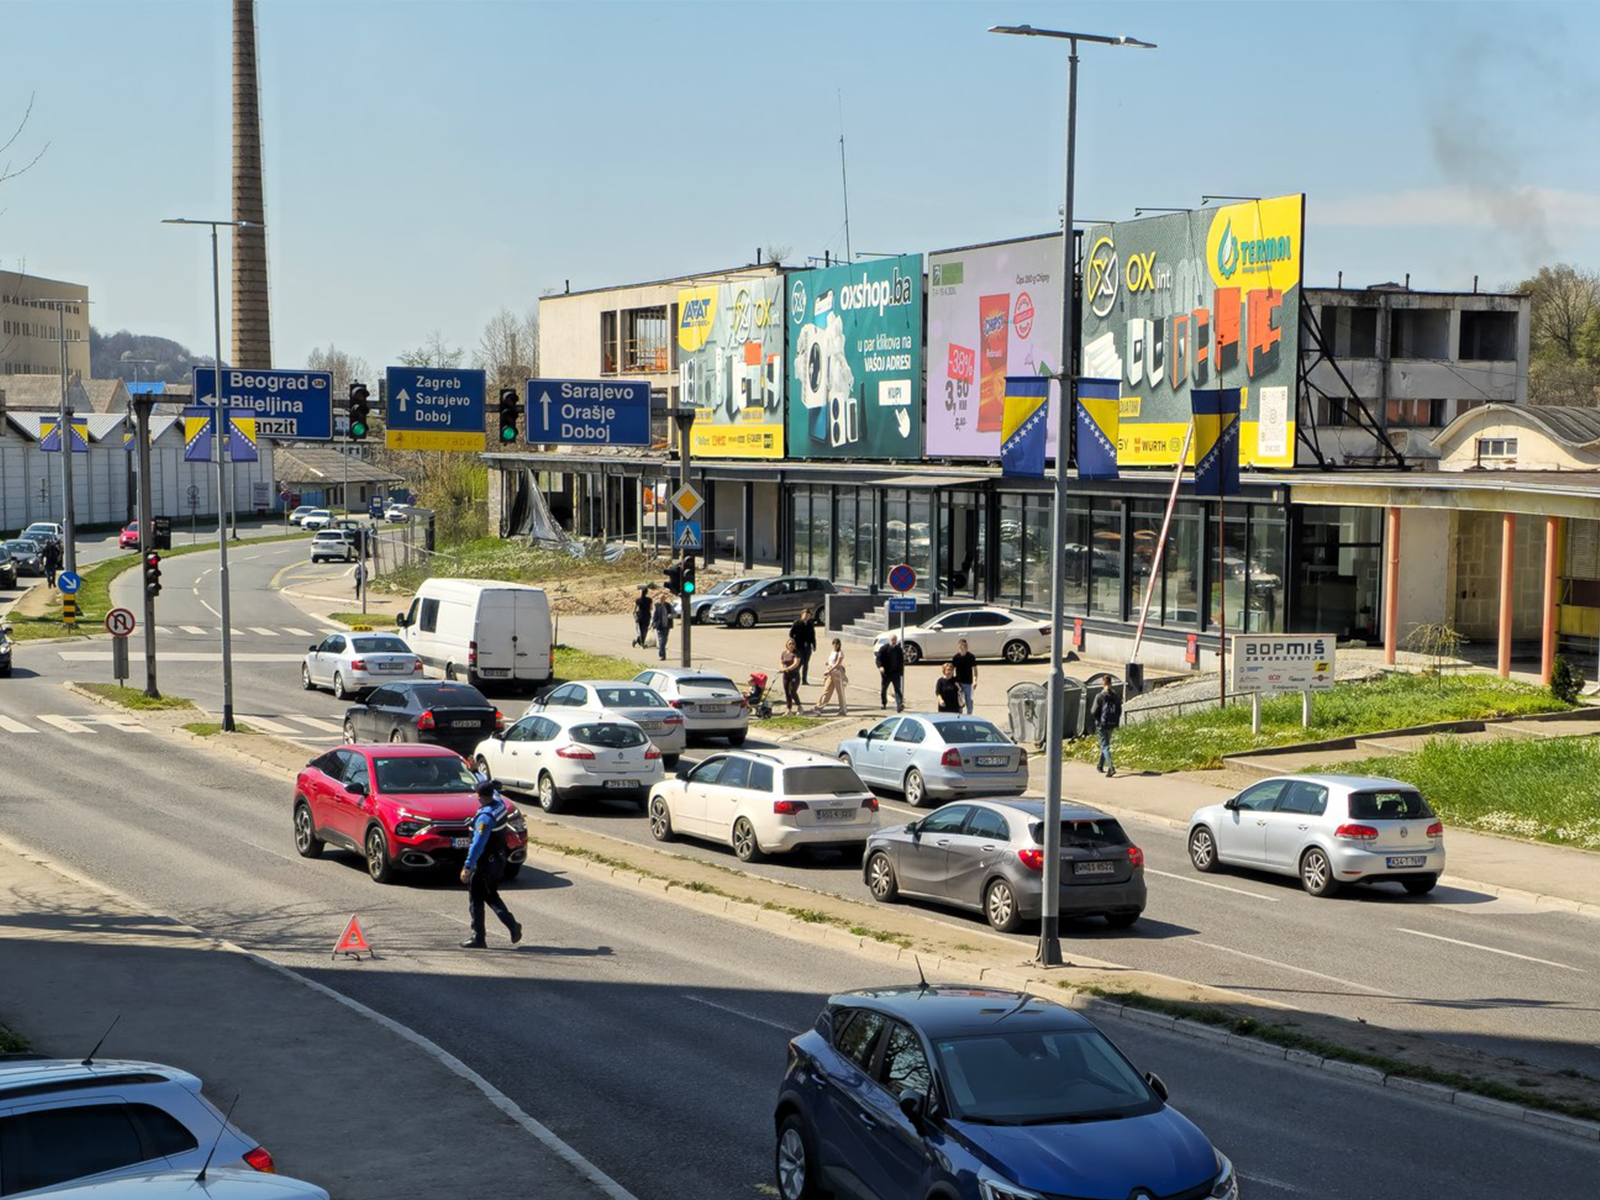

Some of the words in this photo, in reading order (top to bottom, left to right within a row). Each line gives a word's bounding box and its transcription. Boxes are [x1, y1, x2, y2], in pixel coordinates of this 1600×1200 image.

[1241, 236, 1291, 265] TERMAL
[1126, 251, 1156, 292] OX
[1157, 269, 1170, 289] int
[840, 267, 912, 316] oxshop.ba
[857, 339, 863, 353] u
[863, 339, 875, 356] par
[876, 333, 900, 351] klikova
[901, 335, 912, 349] na
[864, 352, 885, 373] VAŠOJ
[886, 354, 912, 371] ADRESI
[948, 349, 974, 376] -38%
[230, 372, 309, 393] Beograd
[416, 375, 461, 391] Zagreb
[561, 382, 635, 402] Sarajevo
[887, 386, 902, 399] KUPI
[416, 392, 470, 409] Sarajevo
[415, 409, 451, 426] Doboj
[561, 403, 616, 424] Orašje
[561, 423, 611, 443] Doboj
